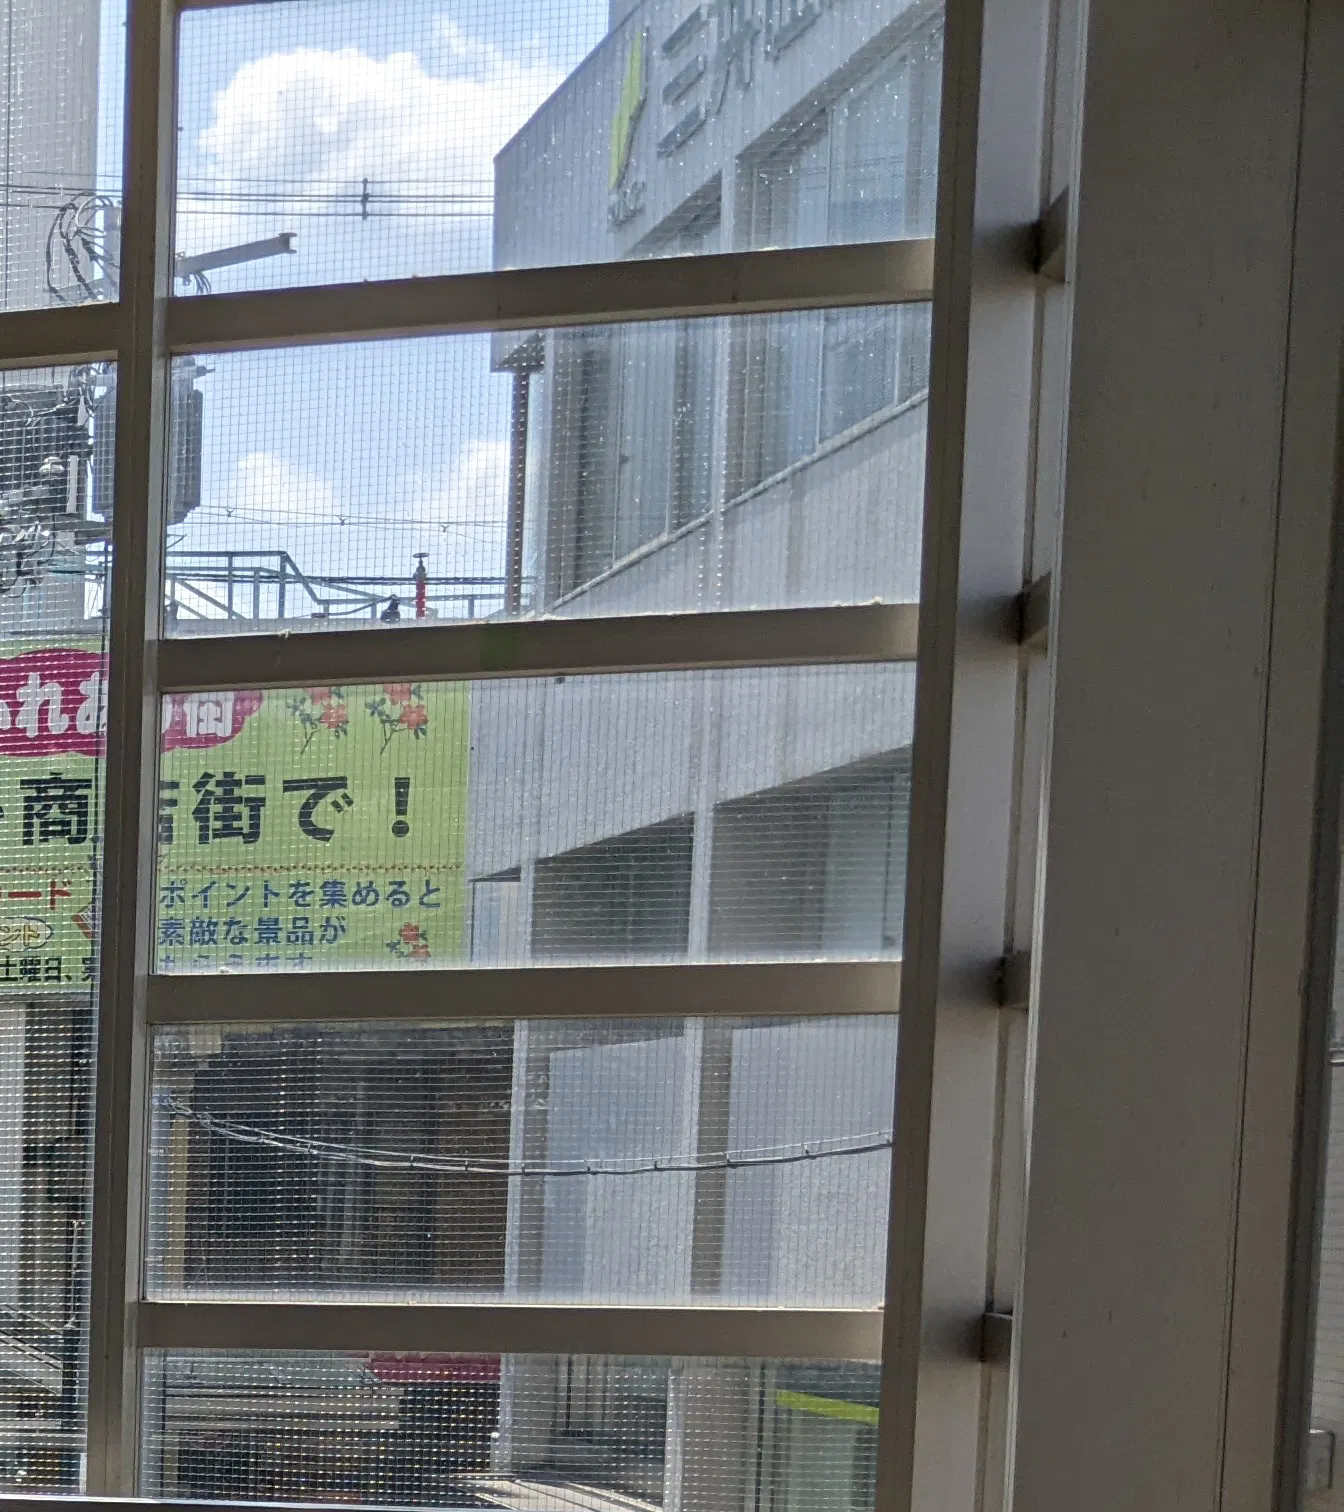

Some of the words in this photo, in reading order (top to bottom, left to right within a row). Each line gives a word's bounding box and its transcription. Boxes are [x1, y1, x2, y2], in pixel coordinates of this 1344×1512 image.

[160, 878, 442, 909] ポイントを集めると
[159, 915, 347, 946] 素敵な景品が
